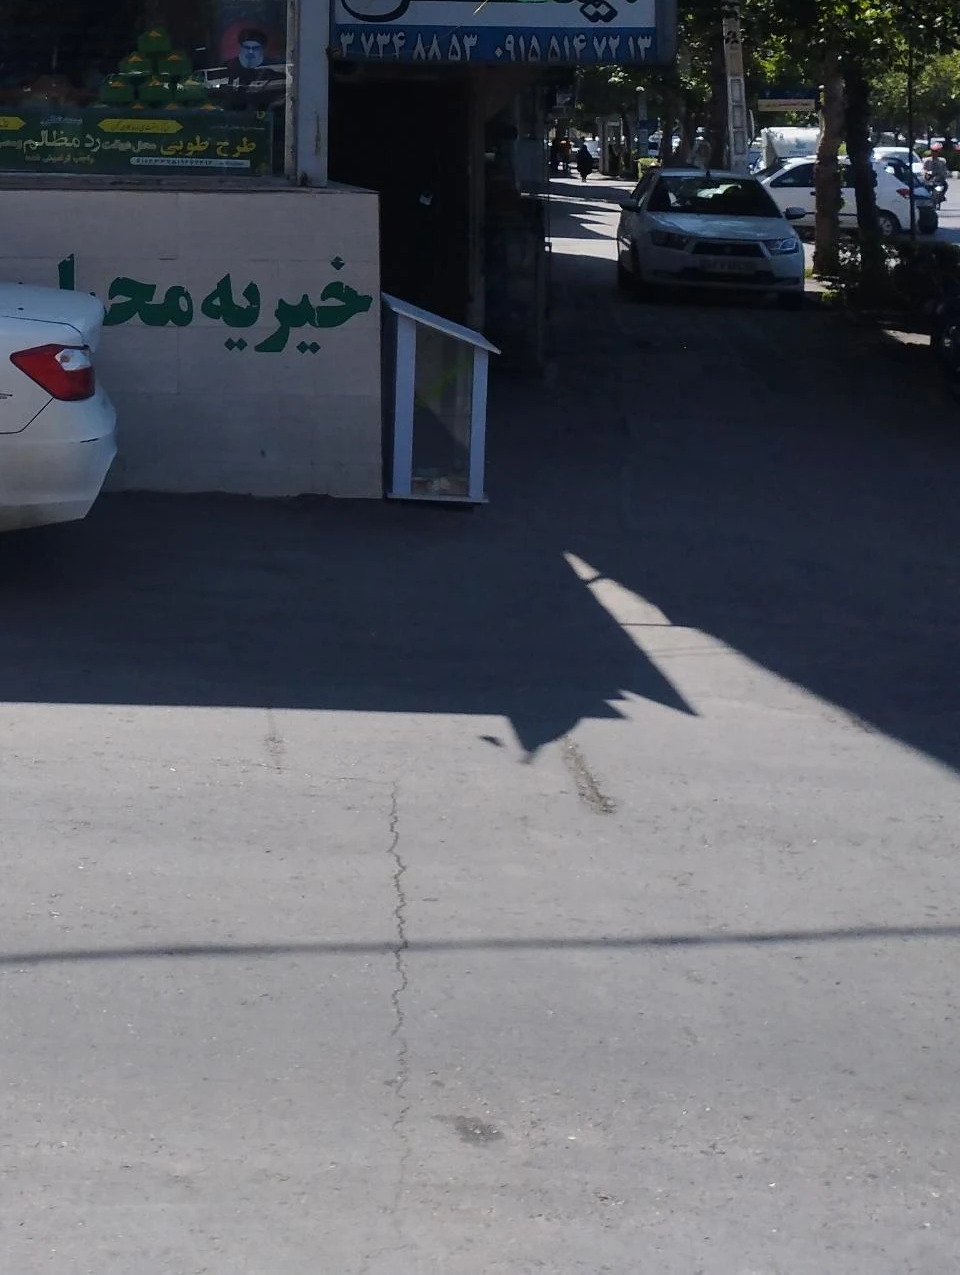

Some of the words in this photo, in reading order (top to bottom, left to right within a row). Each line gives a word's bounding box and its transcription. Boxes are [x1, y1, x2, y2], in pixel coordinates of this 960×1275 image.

[23, 129, 81, 154] مظالم
[84, 133, 102, 153] رد
[159, 135, 210, 158] طوبی
[215, 136, 257, 157] طرح
[57, 253, 194, 327] محا
[200, 255, 373, 353] خیریه
